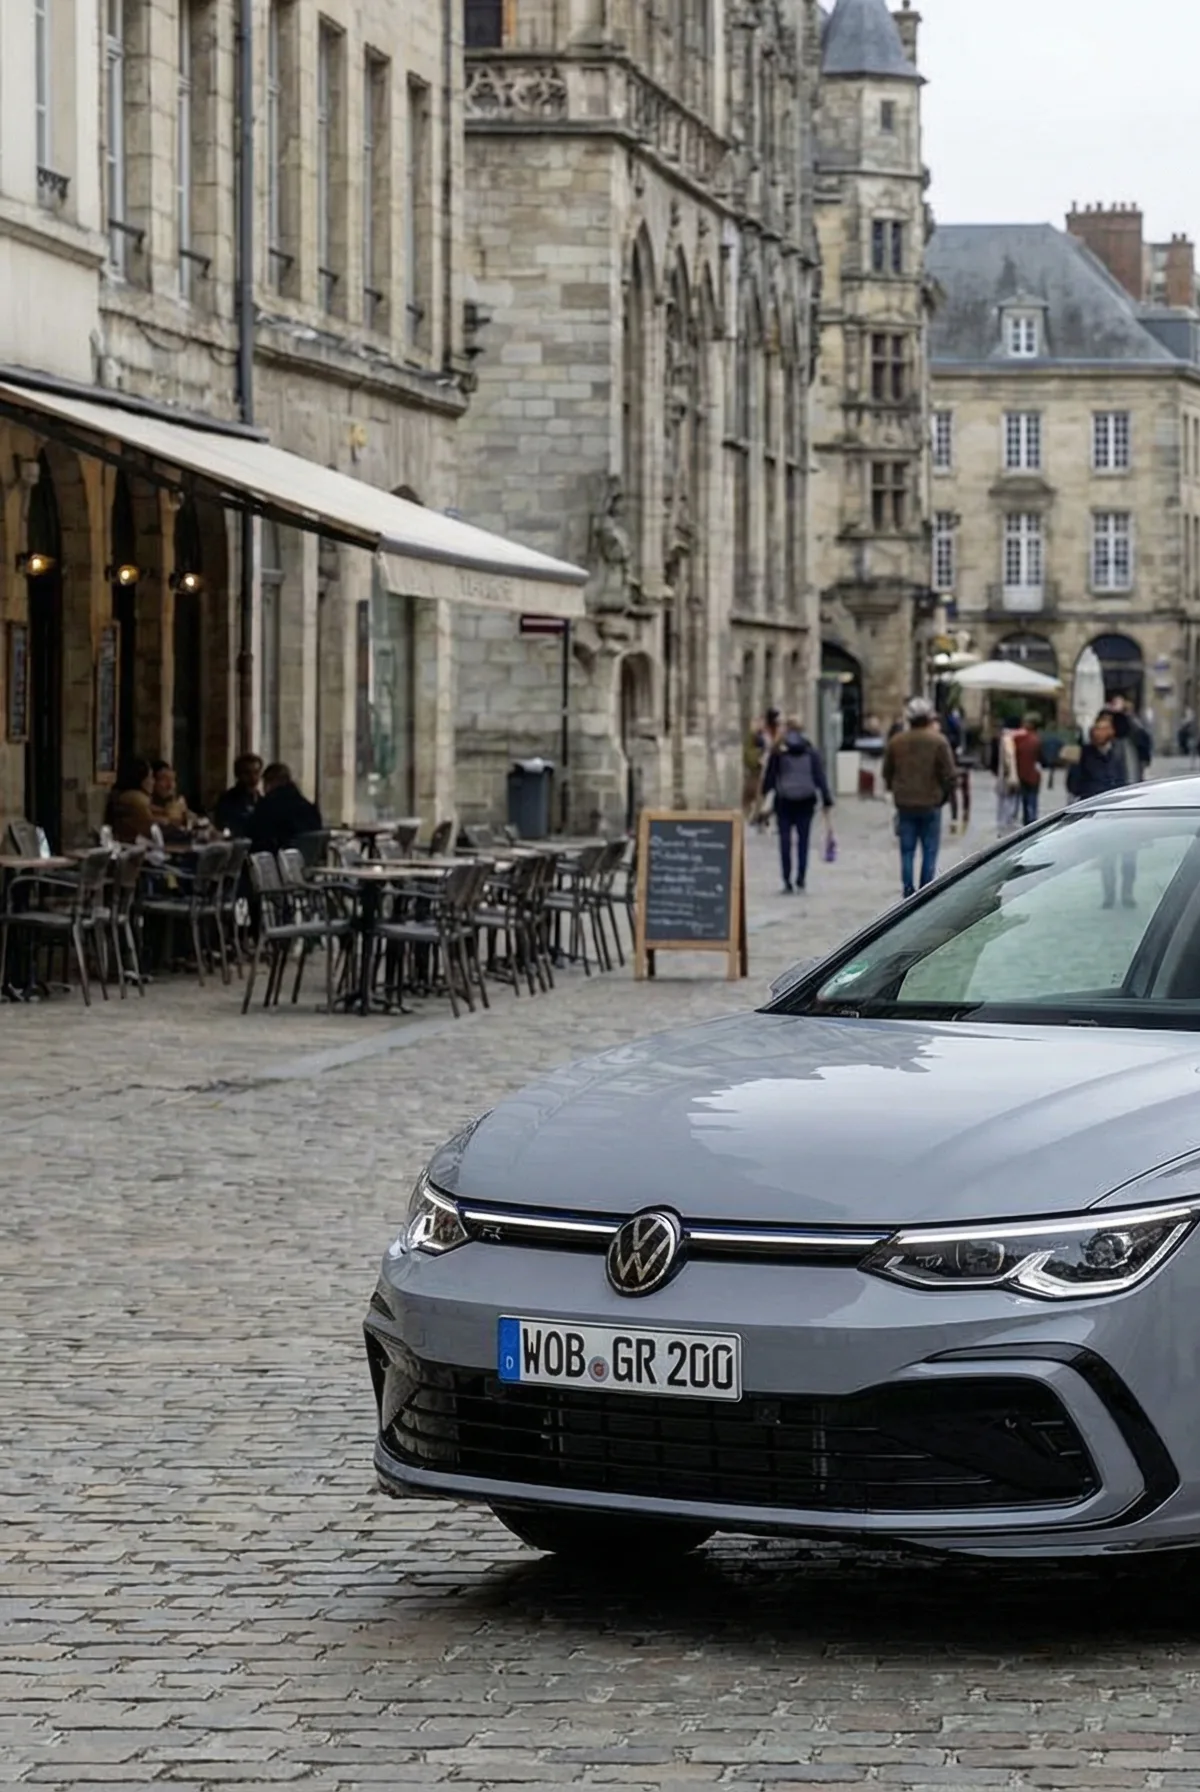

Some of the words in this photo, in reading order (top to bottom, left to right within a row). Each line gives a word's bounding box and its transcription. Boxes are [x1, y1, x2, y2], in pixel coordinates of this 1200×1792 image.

[506, 1355, 514, 1370] D
[523, 1328, 586, 1378] WOB
[613, 1336, 656, 1385] GR
[667, 1341, 733, 1390] 200
